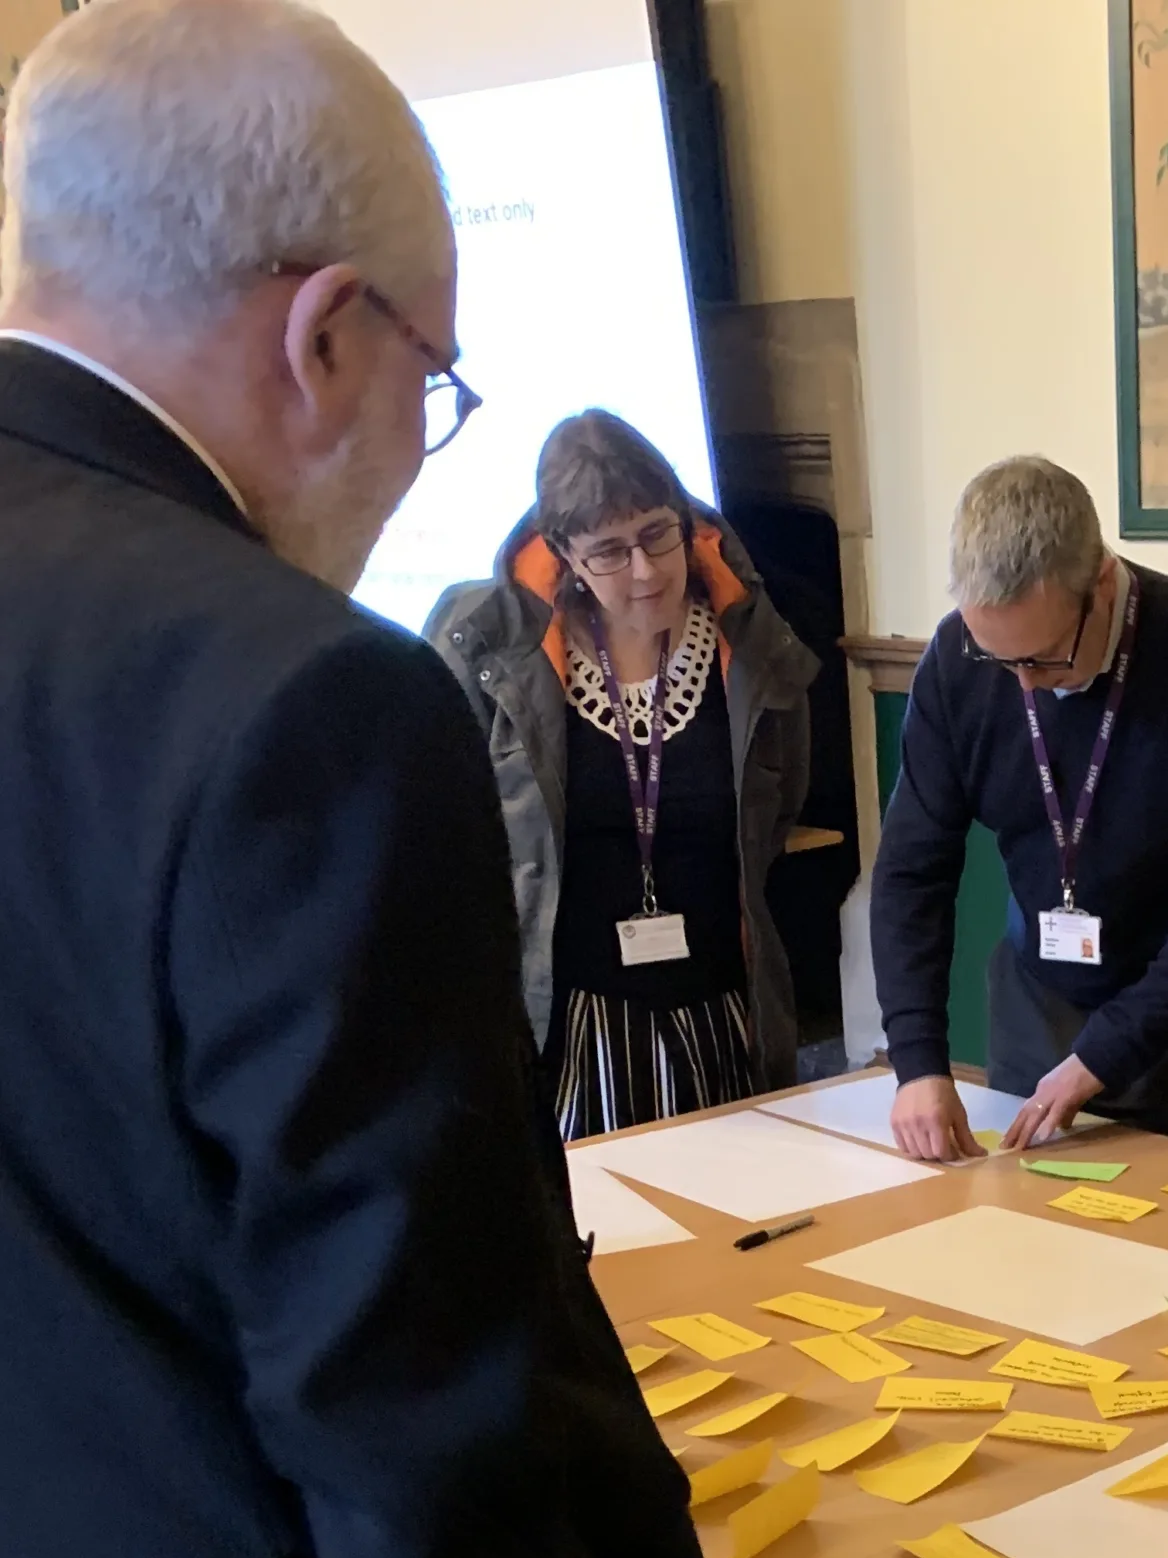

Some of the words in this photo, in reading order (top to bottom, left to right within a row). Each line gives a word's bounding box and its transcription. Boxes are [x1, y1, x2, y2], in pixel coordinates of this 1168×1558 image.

[467, 201, 498, 225] text
[502, 197, 535, 224] only
[1125, 595, 1138, 626] STAFF
[599, 649, 612, 676] STAFF
[1116, 653, 1129, 683] STAFF
[612, 702, 626, 729] STAFF
[1027, 708, 1040, 738] STAFF
[1100, 710, 1114, 740] STAFF
[626, 753, 638, 782] STAFF
[649, 754, 659, 782] STAFF
[1039, 764, 1053, 794] STAFF
[1085, 764, 1099, 794] STAFF
[646, 807, 656, 834] STAFF
[1052, 819, 1066, 848] STAFF
[1072, 817, 1084, 845] STAFF
